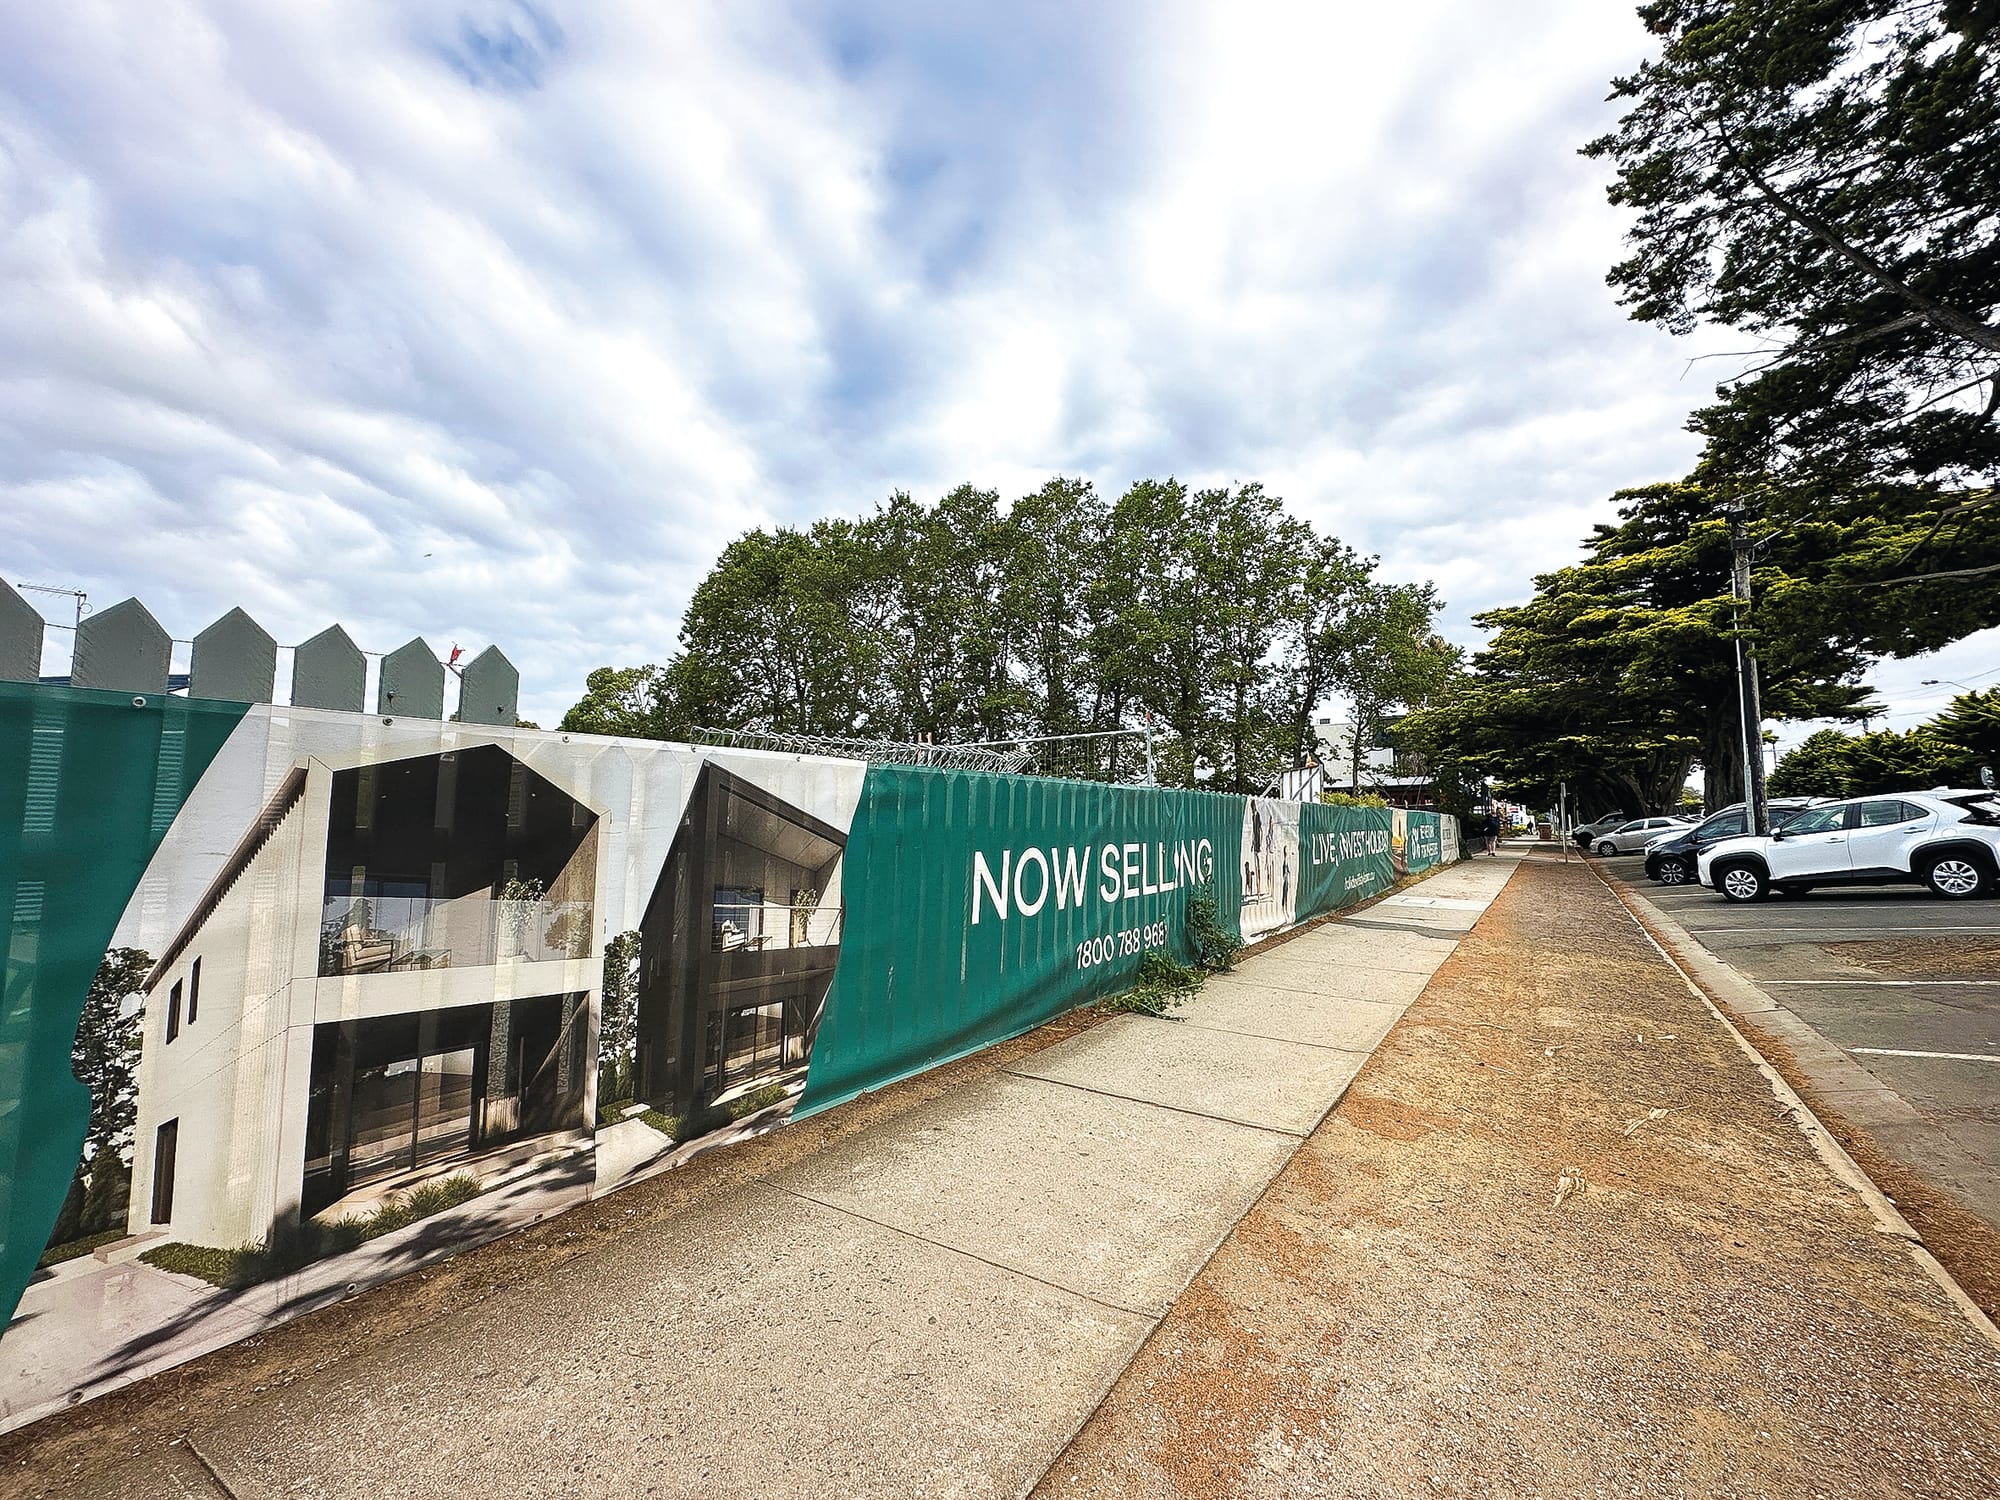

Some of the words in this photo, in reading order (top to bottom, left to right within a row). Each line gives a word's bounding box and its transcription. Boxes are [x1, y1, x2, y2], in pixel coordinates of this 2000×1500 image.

[971, 846, 1091, 924] NOW
[1100, 839, 1212, 903] SELLING
[1076, 936, 1114, 969] 1800
[1117, 927, 1141, 958] 788
[1143, 921, 1167, 949] 968
